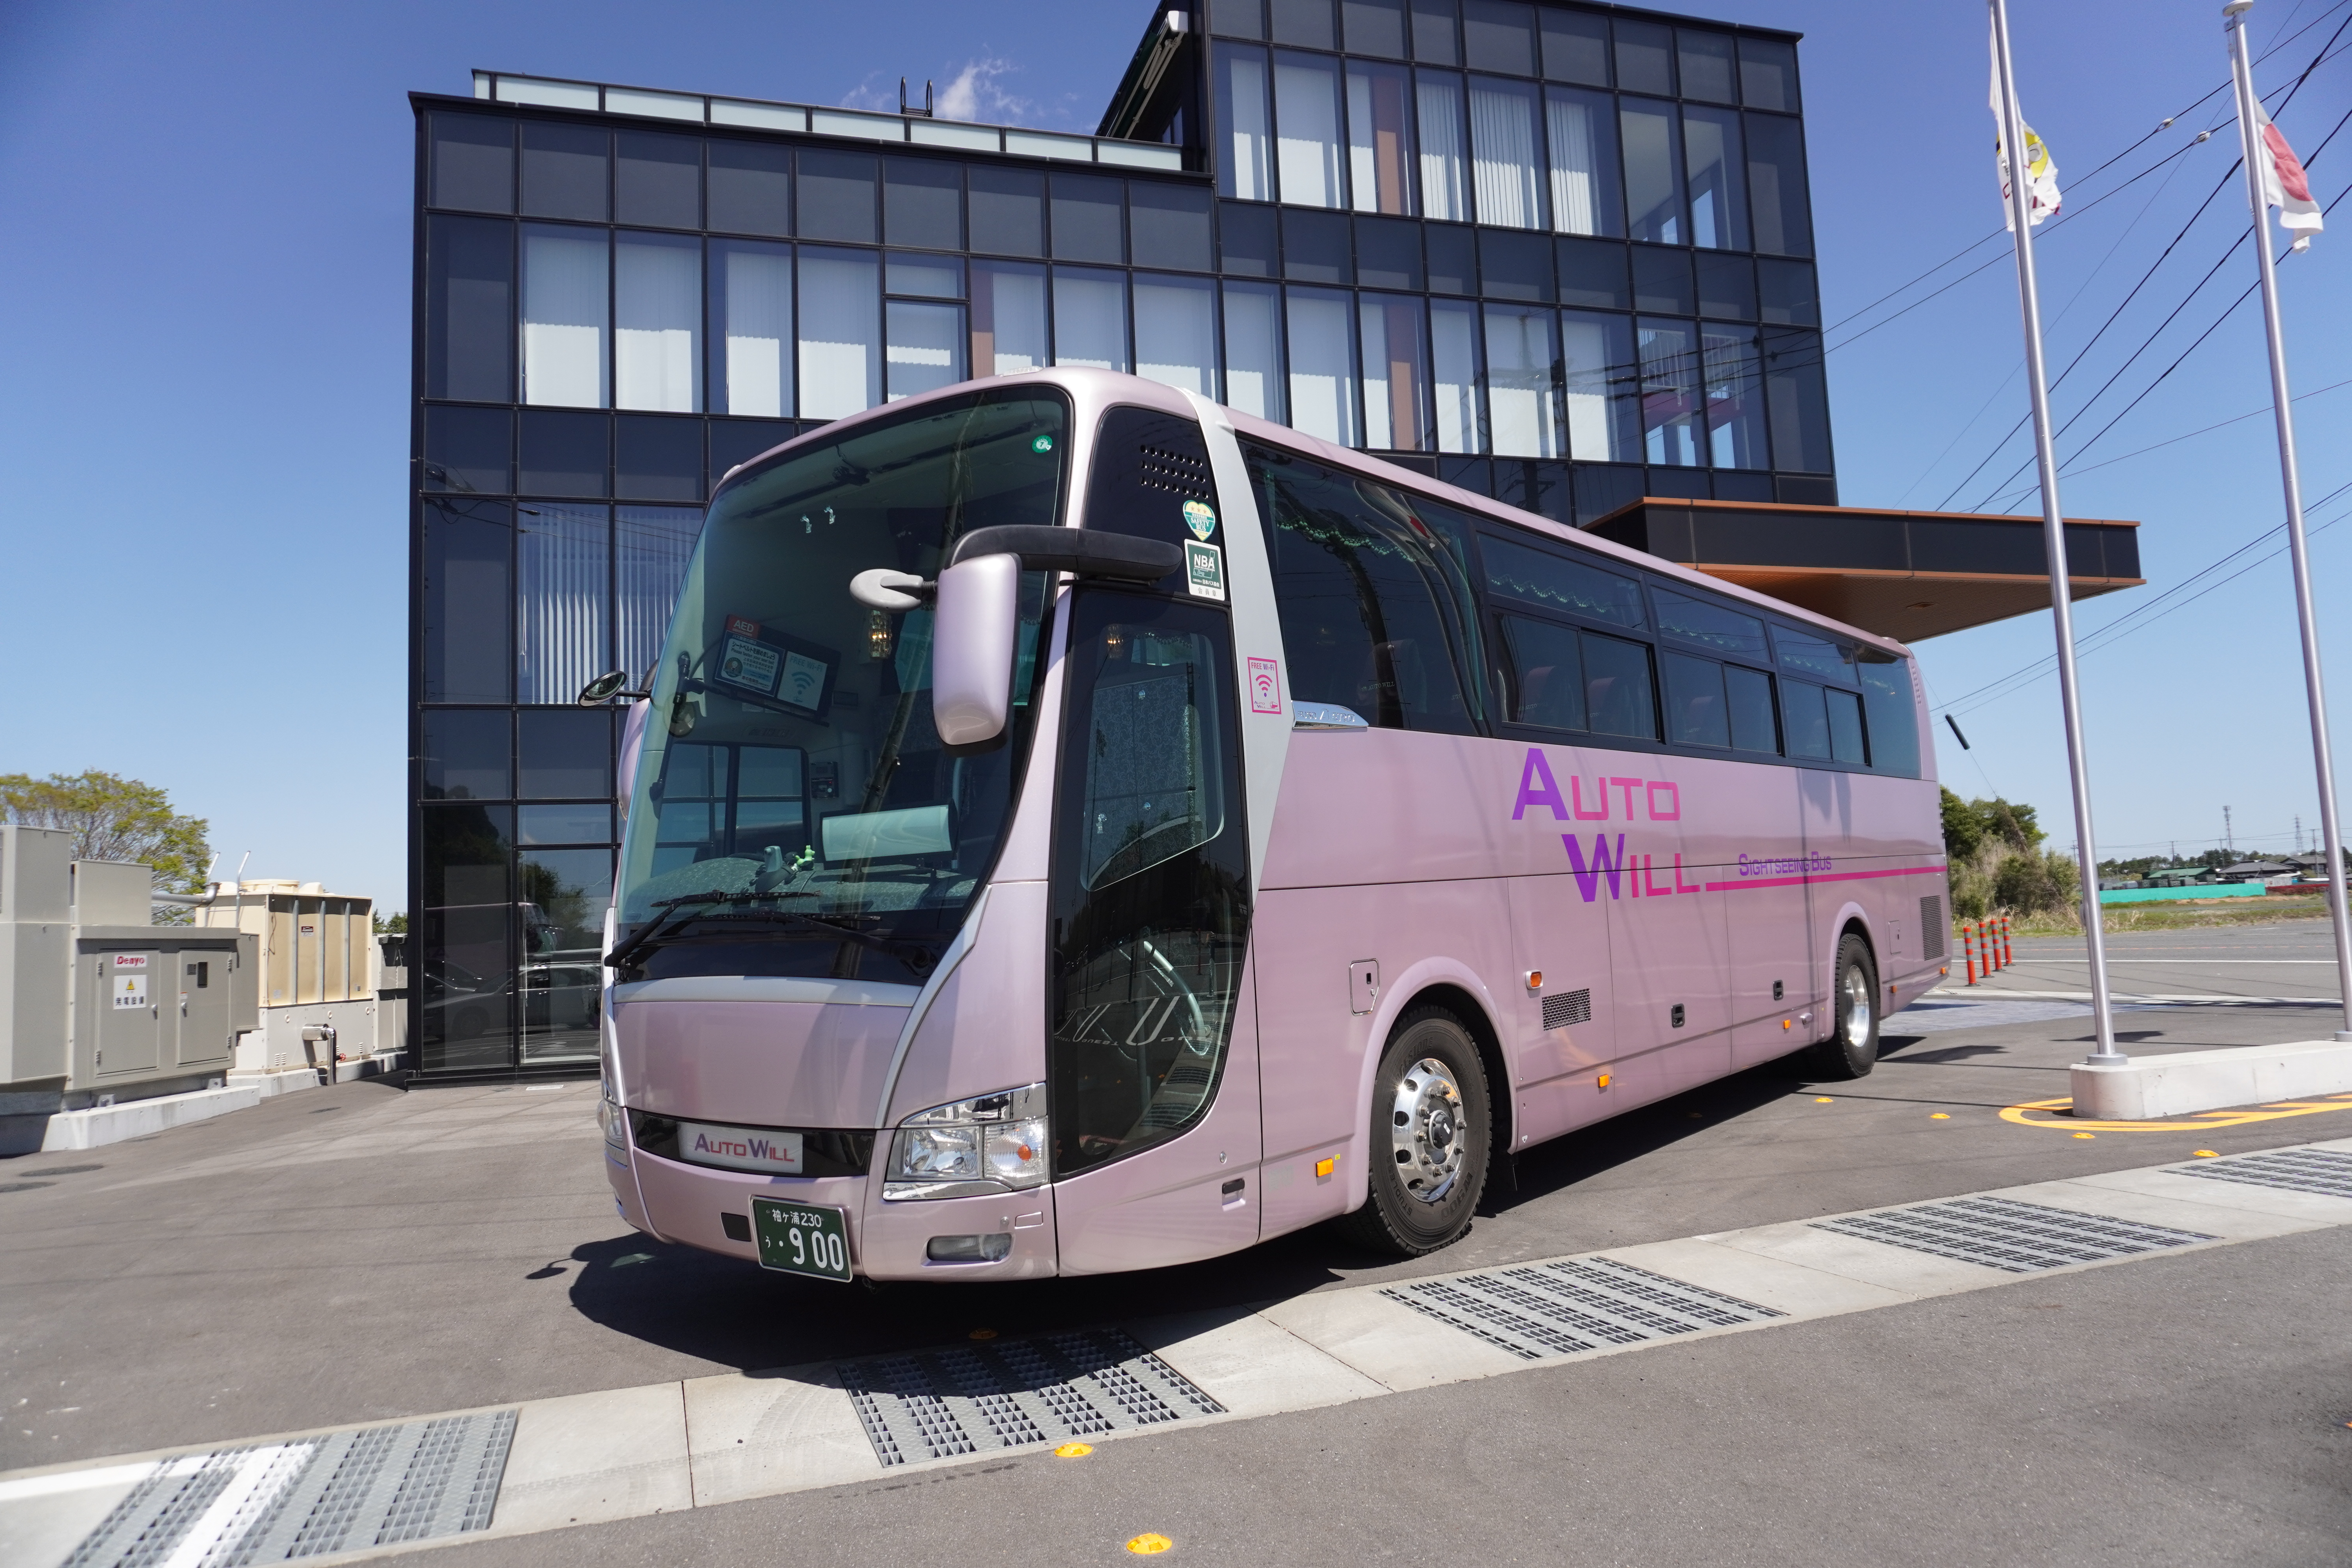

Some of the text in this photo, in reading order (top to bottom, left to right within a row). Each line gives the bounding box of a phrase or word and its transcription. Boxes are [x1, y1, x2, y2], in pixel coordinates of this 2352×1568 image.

[1191, 517, 1209, 527] SAFETY
[1194, 554, 1215, 569] NBA
[1202, 579, 1220, 587] 日本バス協会
[1198, 587, 1217, 597] 会員章
[733, 620, 754, 633] AED
[789, 656, 823, 672] FREE Wi-Fi
[1319, 708, 1355, 722] AERO
[1512, 748, 1681, 821] AUTO
[1561, 833, 1700, 902] WILL
[1739, 851, 1832, 876] SIGHTSEEING BUS
[116, 956, 145, 966] Denyo
[694, 1133, 794, 1162] AUTO WILL
[1387, 1154, 1412, 1215] STUDLESS
[765, 1235, 771, 1248] う
